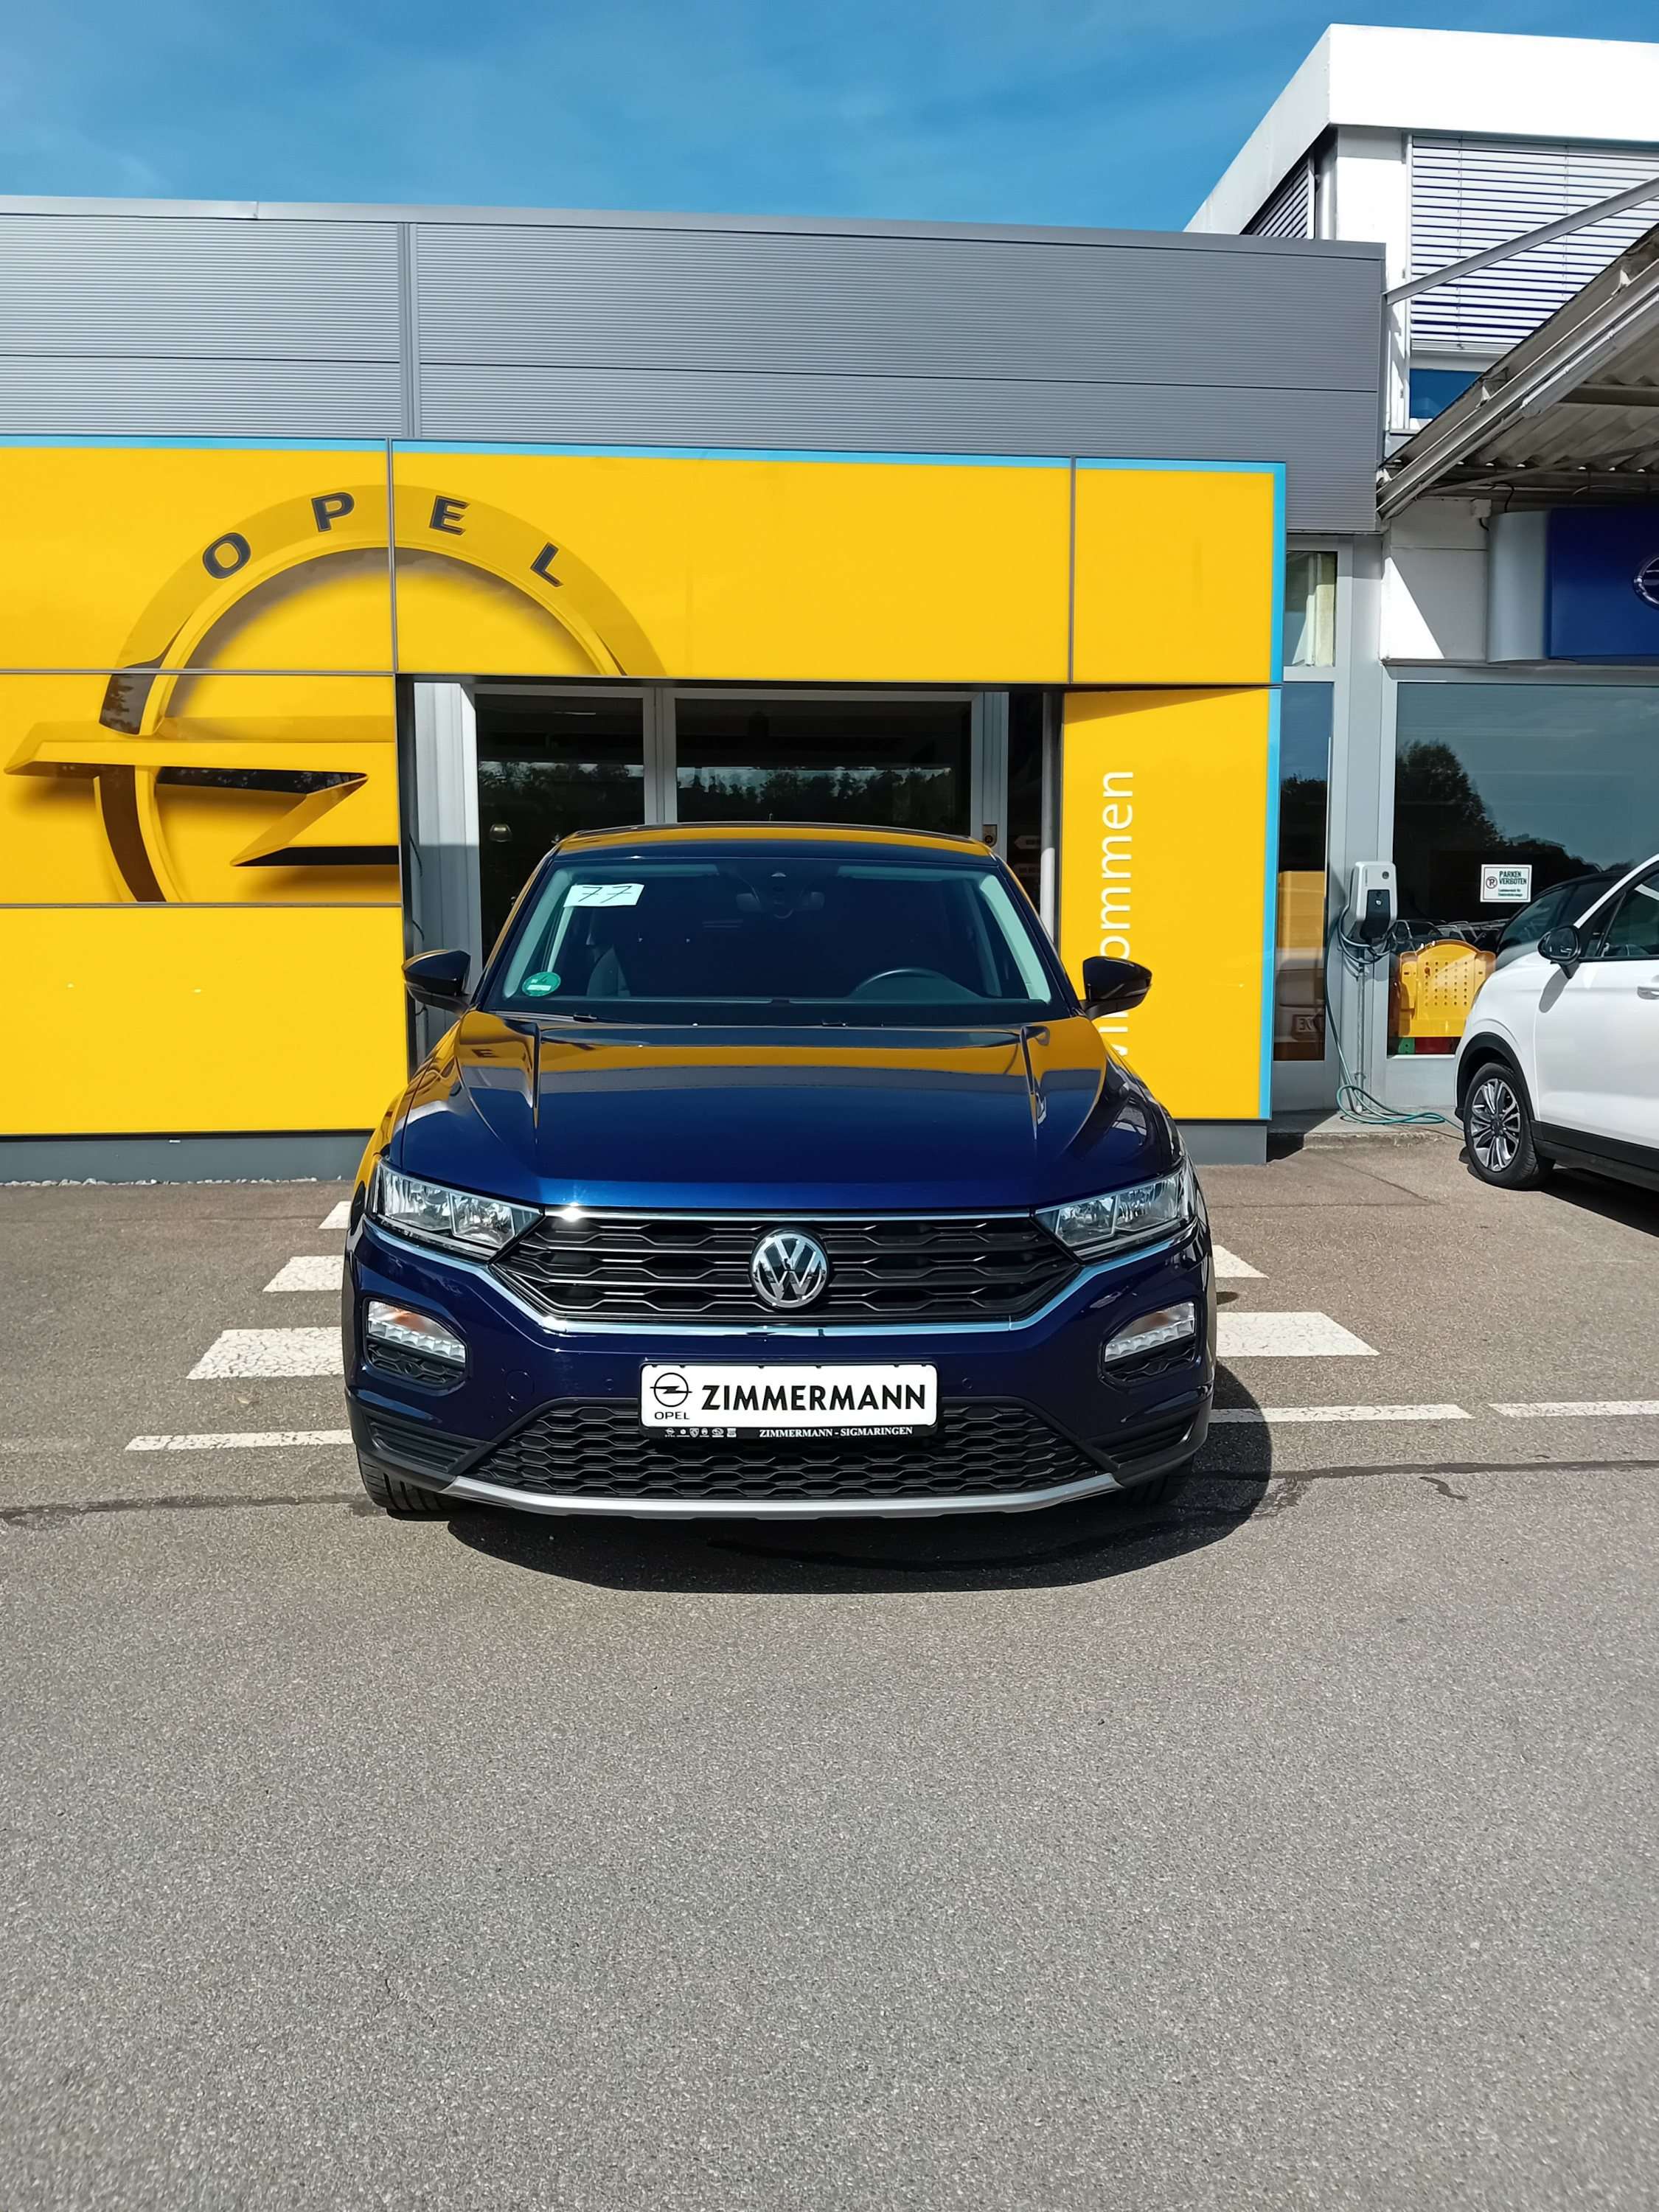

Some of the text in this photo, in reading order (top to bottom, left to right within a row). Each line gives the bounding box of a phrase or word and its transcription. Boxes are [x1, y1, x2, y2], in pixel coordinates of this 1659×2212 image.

[203, 492, 563, 587] OPEL
[578, 886, 632, 903] 77
[702, 1385, 925, 1411] ZIMMERMANN
[654, 1411, 690, 1419] OPEL
